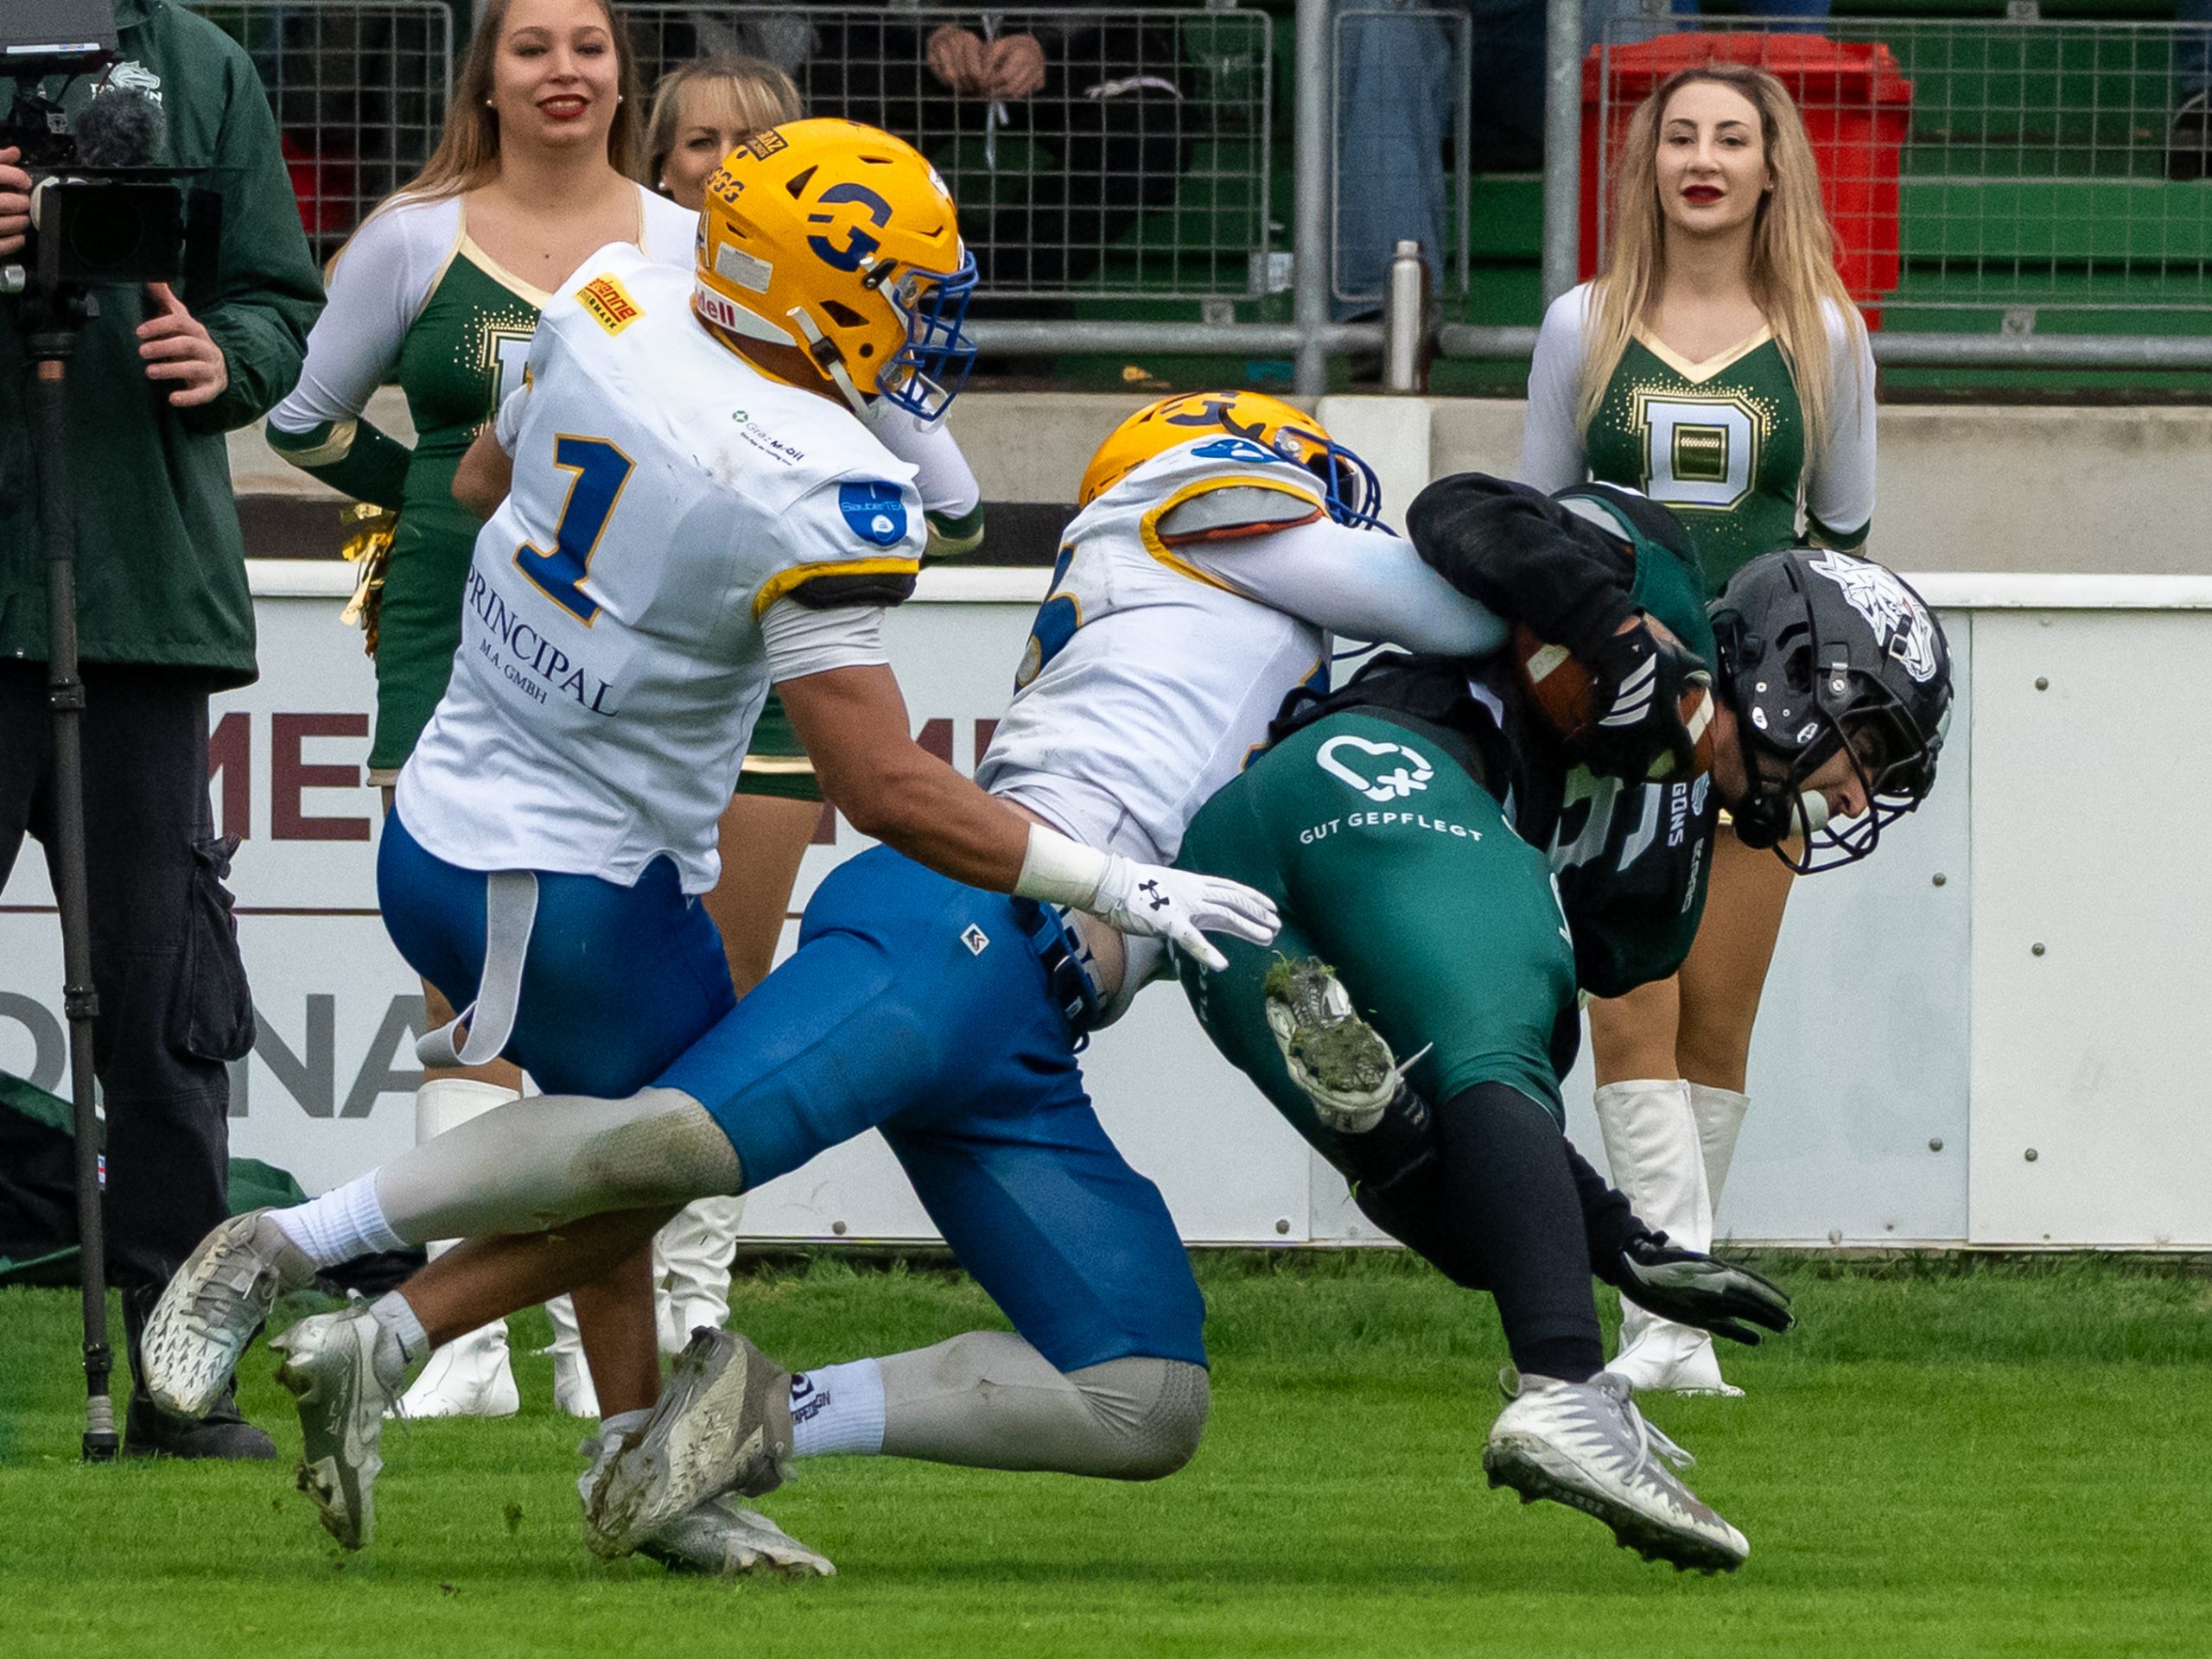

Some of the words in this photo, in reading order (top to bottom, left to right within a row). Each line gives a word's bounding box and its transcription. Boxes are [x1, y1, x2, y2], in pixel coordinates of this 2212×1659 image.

[698, 289, 735, 327] dell
[1639, 396, 1758, 511] D
[512, 433, 636, 628] 1
[505, 664, 548, 704] GMBH
[1300, 819, 1340, 844] GUT
[1347, 811, 1483, 842] GEPFLEGT
[1668, 782, 1688, 847] GONS
